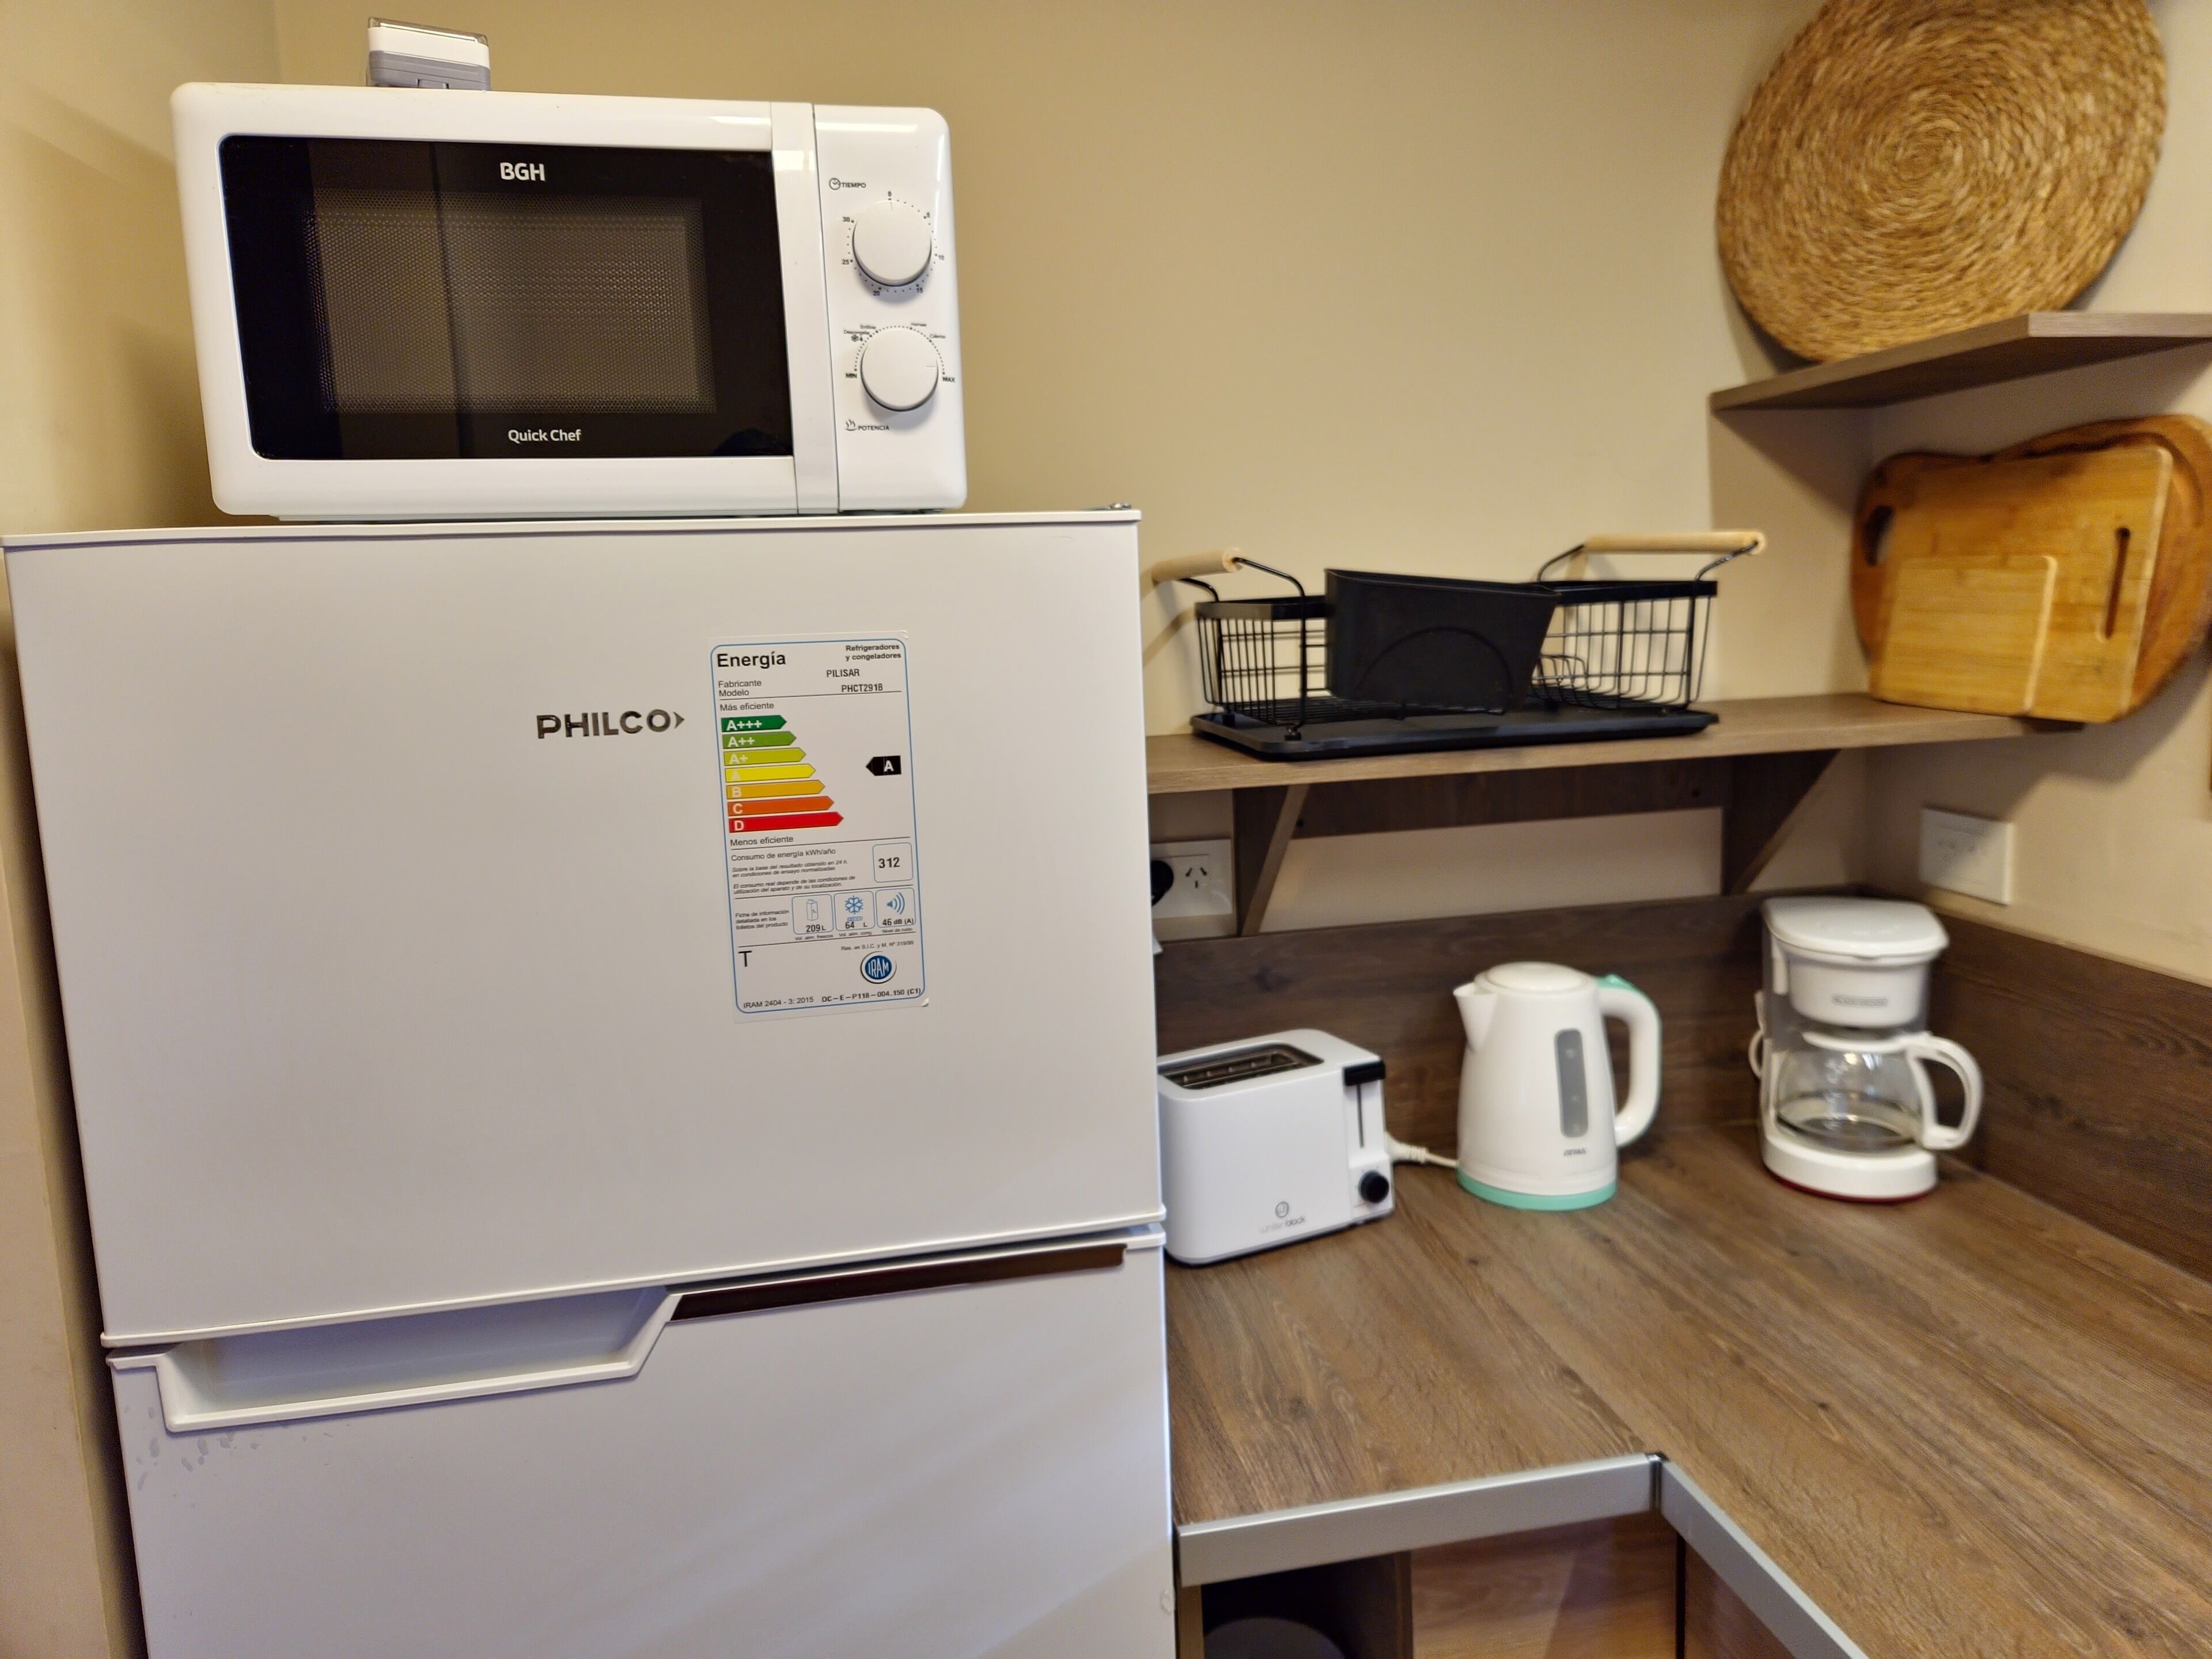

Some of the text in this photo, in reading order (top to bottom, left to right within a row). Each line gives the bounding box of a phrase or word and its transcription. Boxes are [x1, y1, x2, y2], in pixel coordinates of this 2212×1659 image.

[500, 162, 546, 181] BGH
[508, 429, 581, 444] Quick Chef
[717, 644, 900, 669] Energía Refrigeradores
[852, 652, 901, 661] congeladores
[826, 669, 860, 678] PILISAR
[718, 680, 762, 688] Fabricante
[842, 683, 883, 693] PHCT291B
[721, 702, 774, 711] Más eficiente
[536, 709, 671, 738] PHILCO
[726, 719, 762, 730] A+++
[728, 736, 755, 747] A++
[729, 754, 748, 764] A+
[884, 760, 894, 772] A
[731, 771, 741, 781] A
[732, 787, 742, 797] B
[733, 804, 743, 813] C
[734, 820, 744, 831] D
[730, 836, 794, 846] Menos eficiente
[878, 857, 900, 869] 312
[738, 950, 752, 967] T
[868, 957, 889, 978] IRAM
